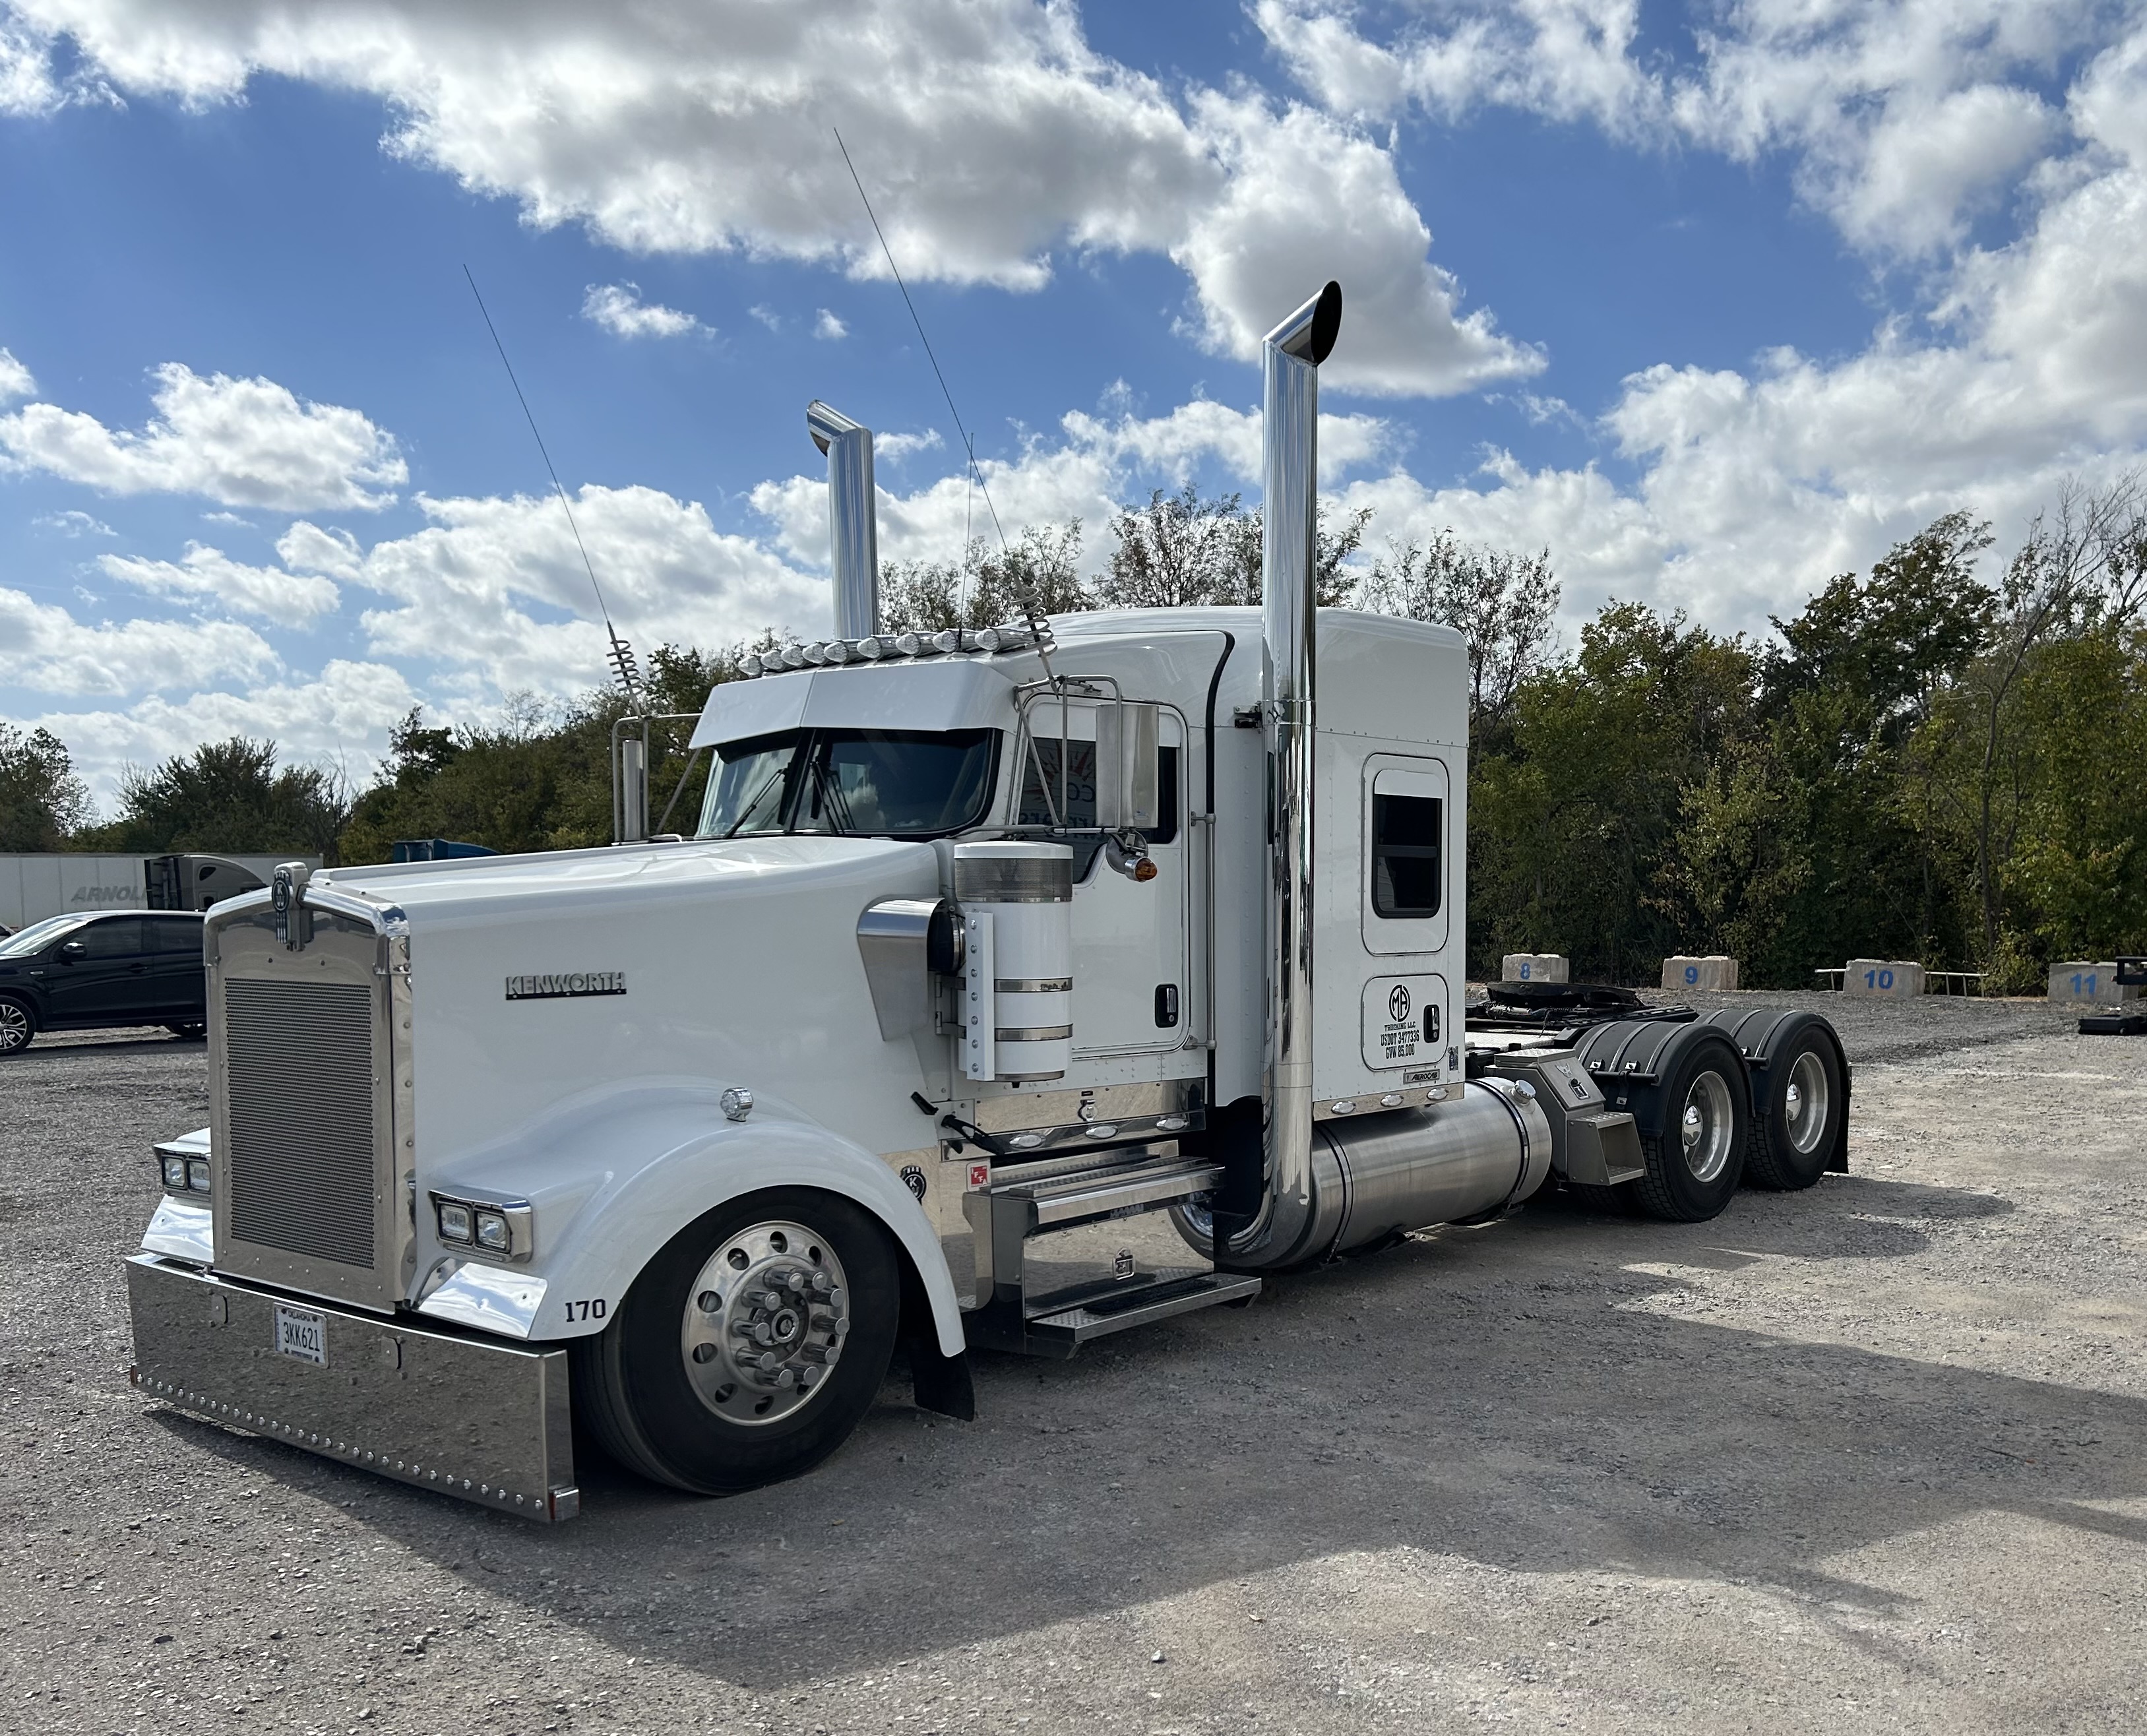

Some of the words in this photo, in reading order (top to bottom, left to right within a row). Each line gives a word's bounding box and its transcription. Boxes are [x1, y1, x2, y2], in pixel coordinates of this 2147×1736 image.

[71, 886, 146, 902] ARNOL
[1520, 962, 1530, 979] 8
[1685, 966, 1698, 984] 9
[1864, 970, 1893, 989] 10
[506, 972, 625, 995] KENWORTH
[2070, 973, 2096, 995] 11
[1381, 1032, 1397, 1046] USDOT
[1386, 1046, 1397, 1059] GVW
[1412, 1072, 1437, 1081] AEROCAB
[565, 1299, 606, 1322] 170
[284, 1322, 320, 1351] 3KK621
